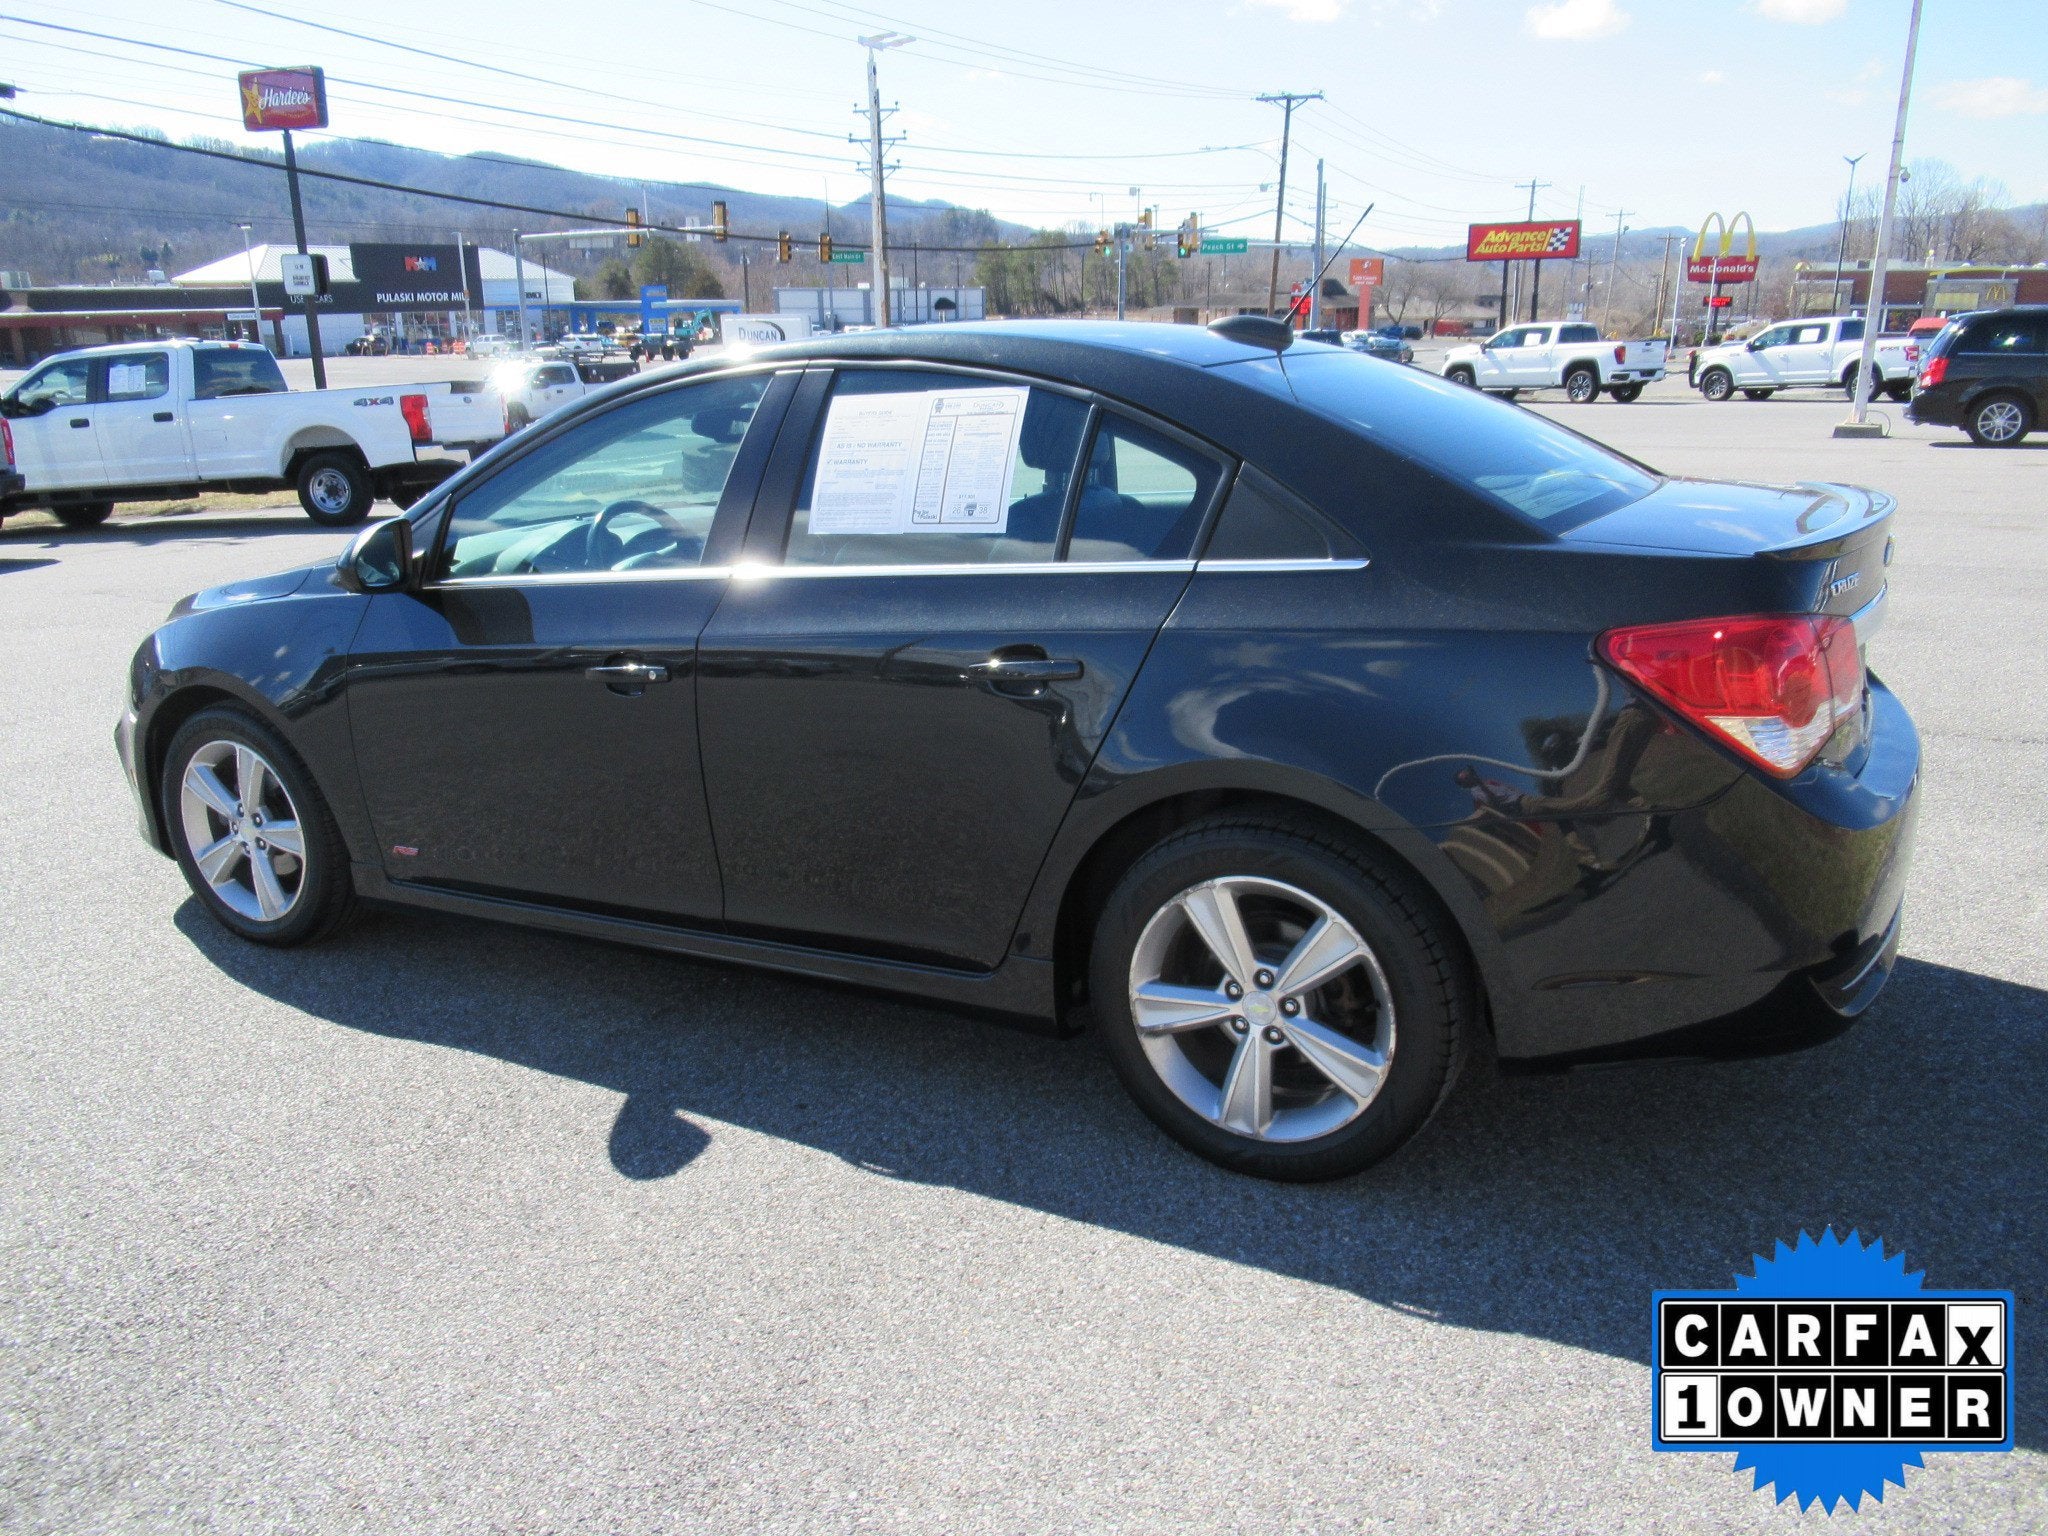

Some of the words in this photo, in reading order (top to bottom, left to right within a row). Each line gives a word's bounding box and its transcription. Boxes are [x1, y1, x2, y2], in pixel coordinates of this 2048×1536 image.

[258, 87, 311, 110] Hardee's
[1486, 229, 1547, 243] Advance
[1474, 242, 1508, 254] Auto
[1507, 241, 1543, 253] Parts
[1689, 264, 1754, 273] McDonald's
[376, 293, 414, 303] PULASKI
[417, 292, 450, 302] MOTOR
